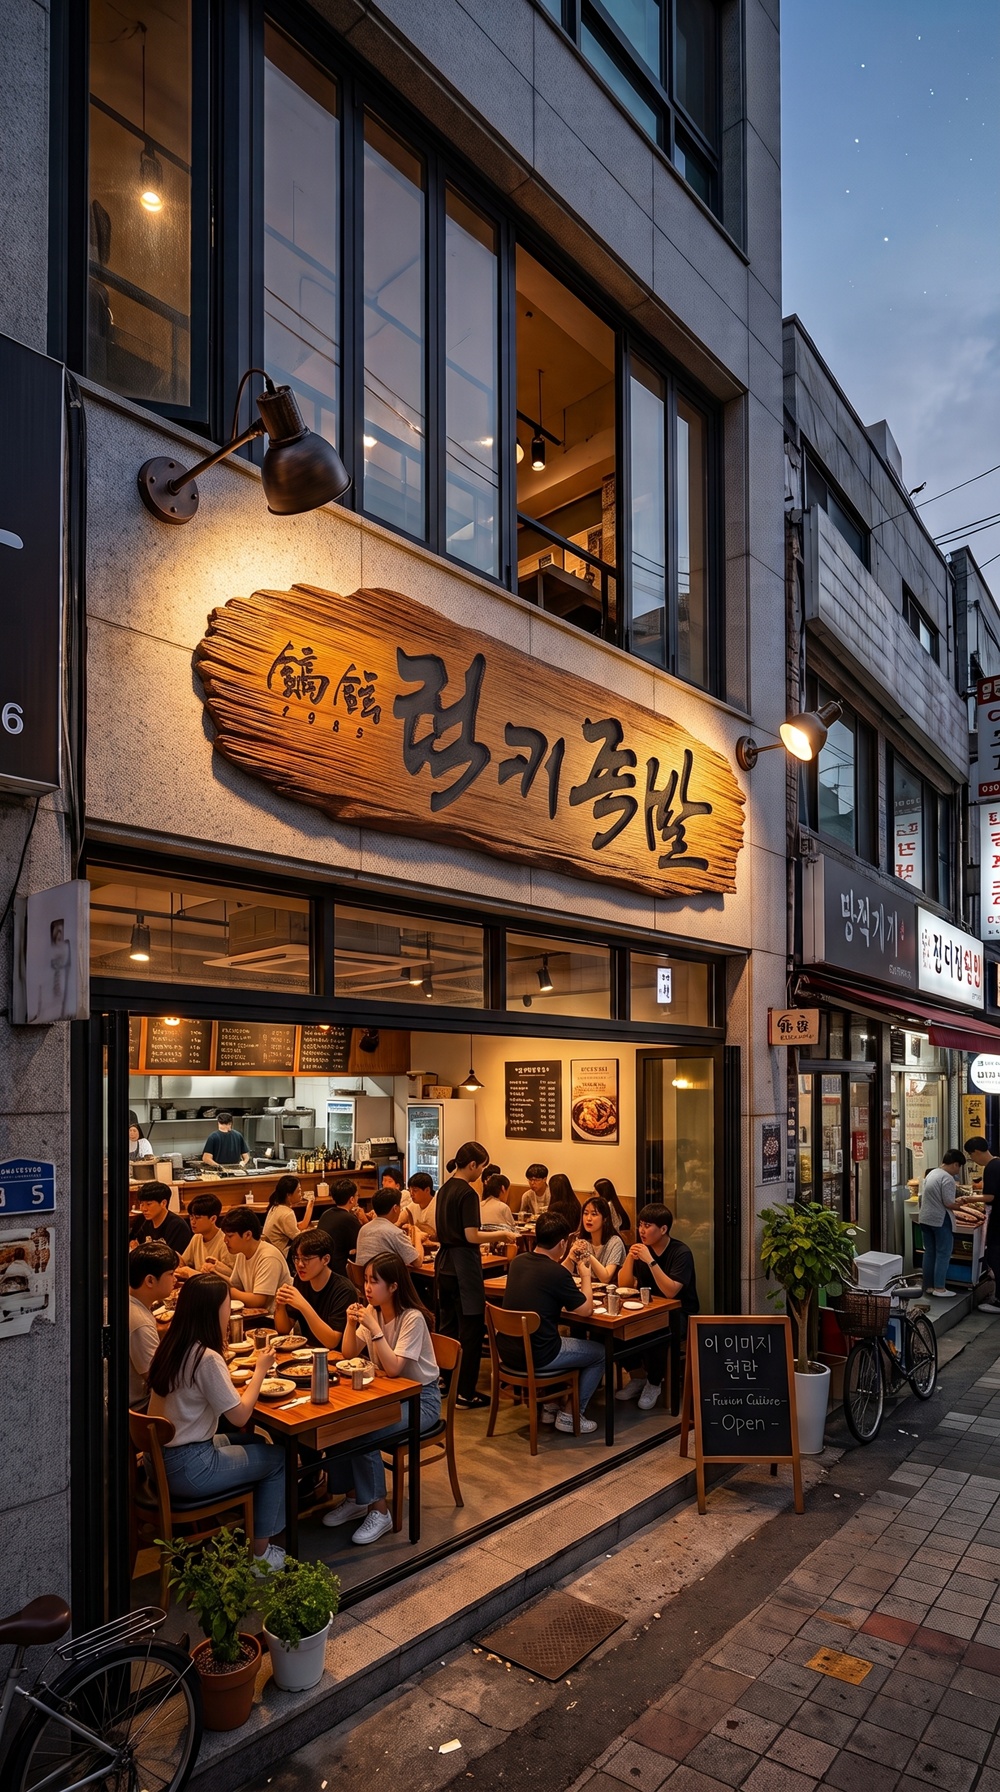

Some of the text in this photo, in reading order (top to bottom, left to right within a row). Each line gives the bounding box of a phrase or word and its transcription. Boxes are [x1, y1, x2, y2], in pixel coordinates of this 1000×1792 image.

[704, 1333, 772, 1354] 이 이미지
[722, 1414, 766, 1437] Open
